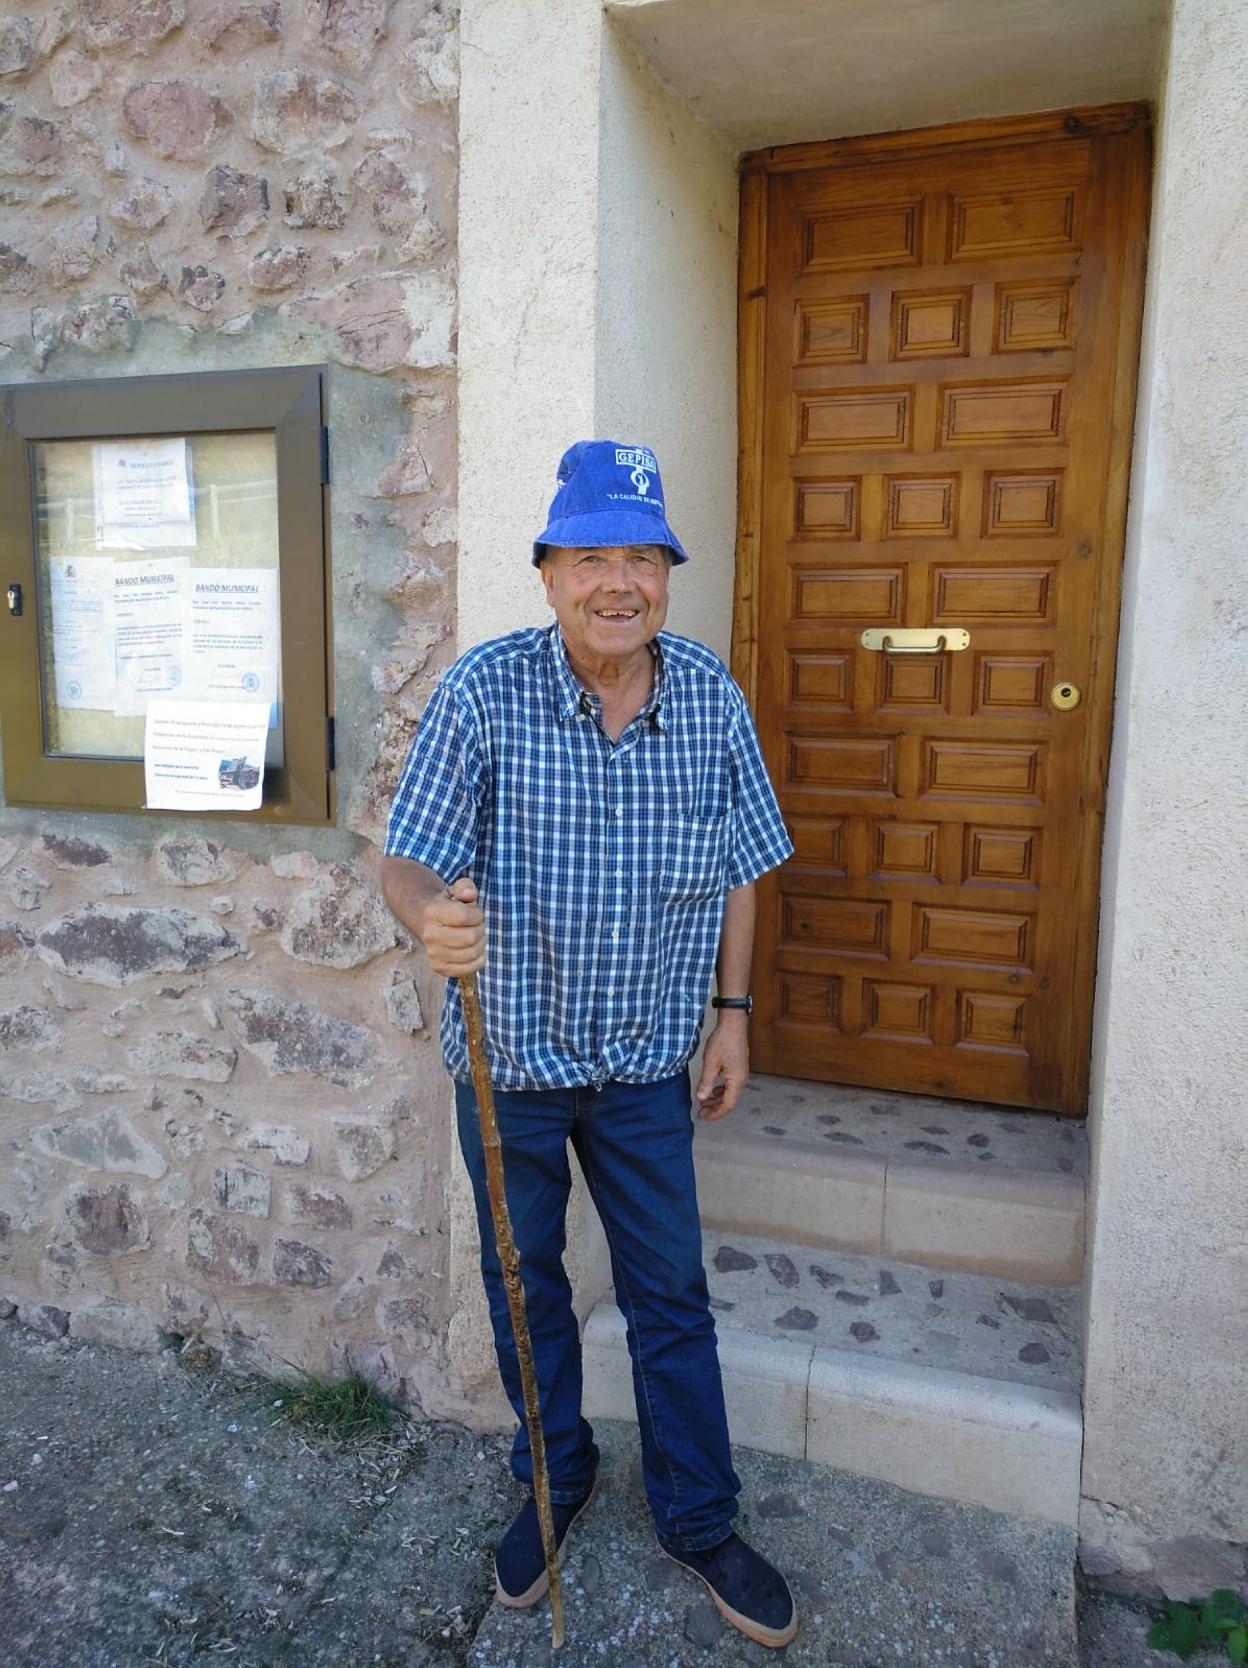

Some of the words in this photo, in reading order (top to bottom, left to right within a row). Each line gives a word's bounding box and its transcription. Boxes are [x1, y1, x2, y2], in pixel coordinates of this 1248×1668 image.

[115, 577, 138, 585] BANDO
[140, 574, 175, 584] MUNICIPAL
[196, 584, 220, 593] BANDO
[221, 584, 258, 593] MUNICIPAL
